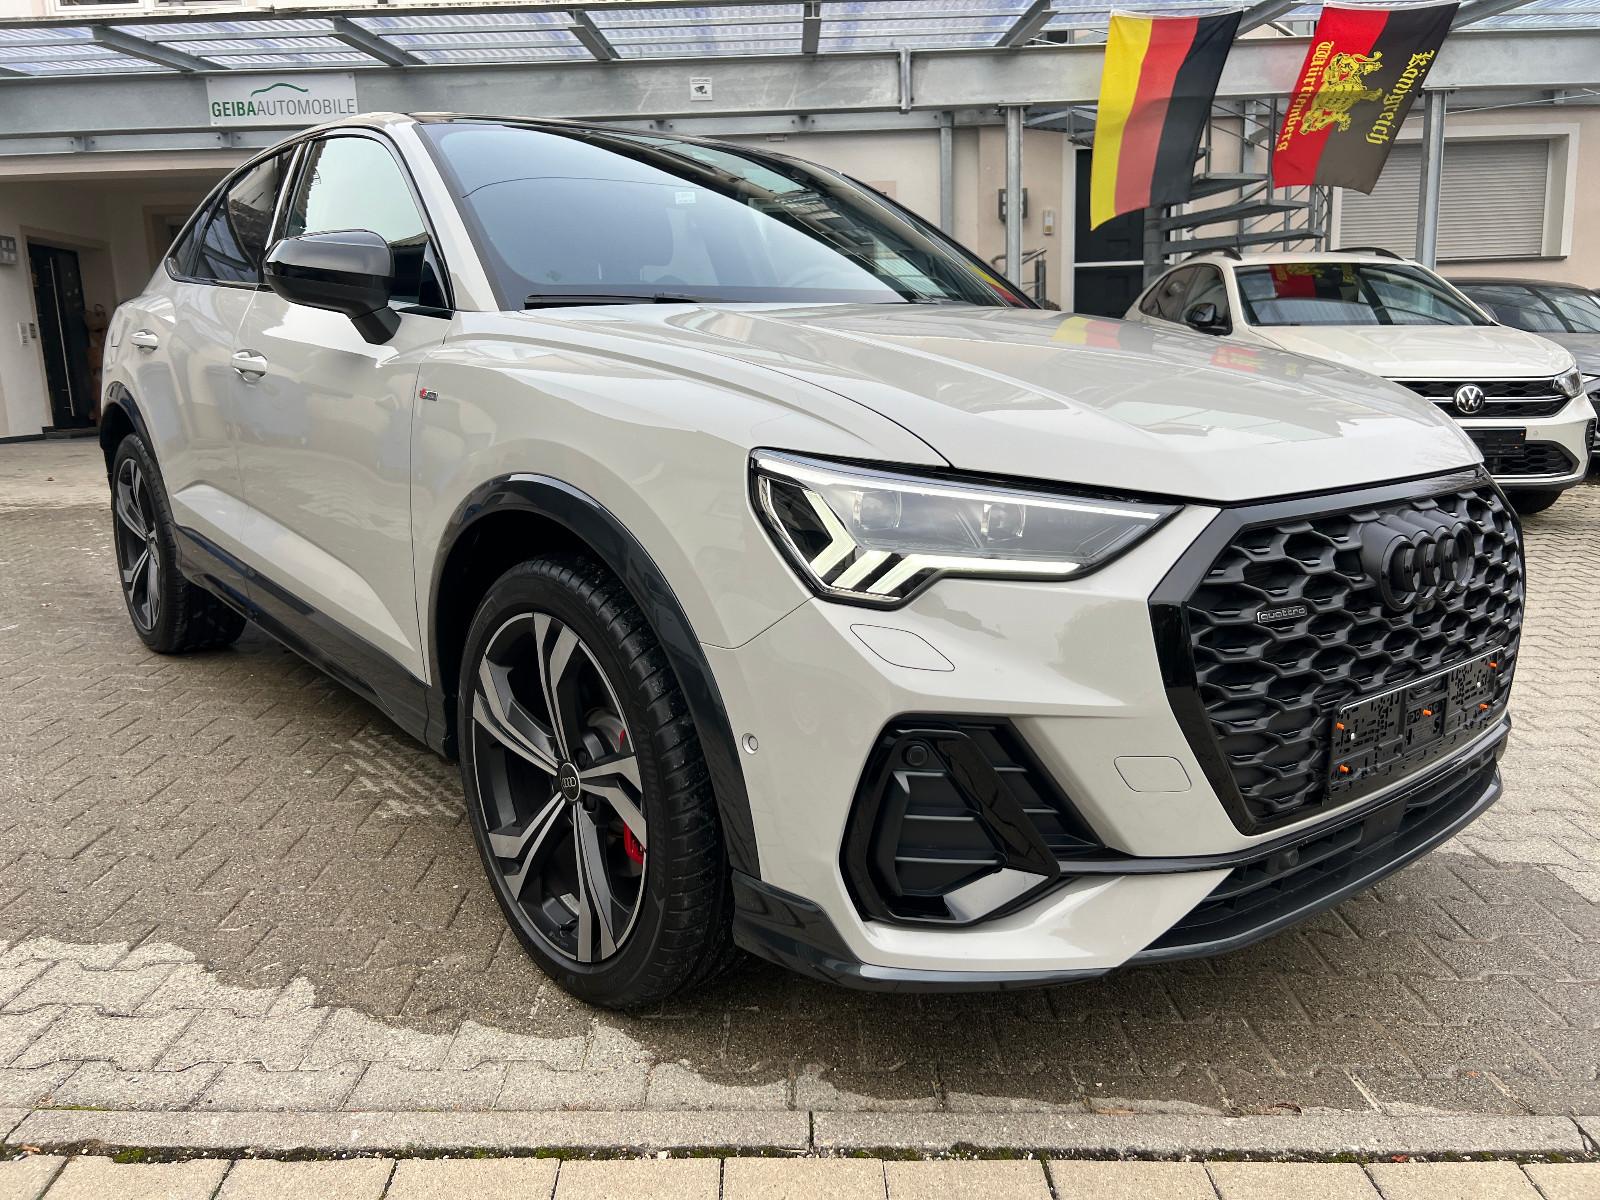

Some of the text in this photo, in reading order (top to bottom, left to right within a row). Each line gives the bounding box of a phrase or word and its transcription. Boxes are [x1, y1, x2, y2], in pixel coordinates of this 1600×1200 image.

[1276, 40, 1334, 152] Württemberg
[1365, 49, 1435, 145] Königreich
[1260, 607, 1306, 620] quattro
